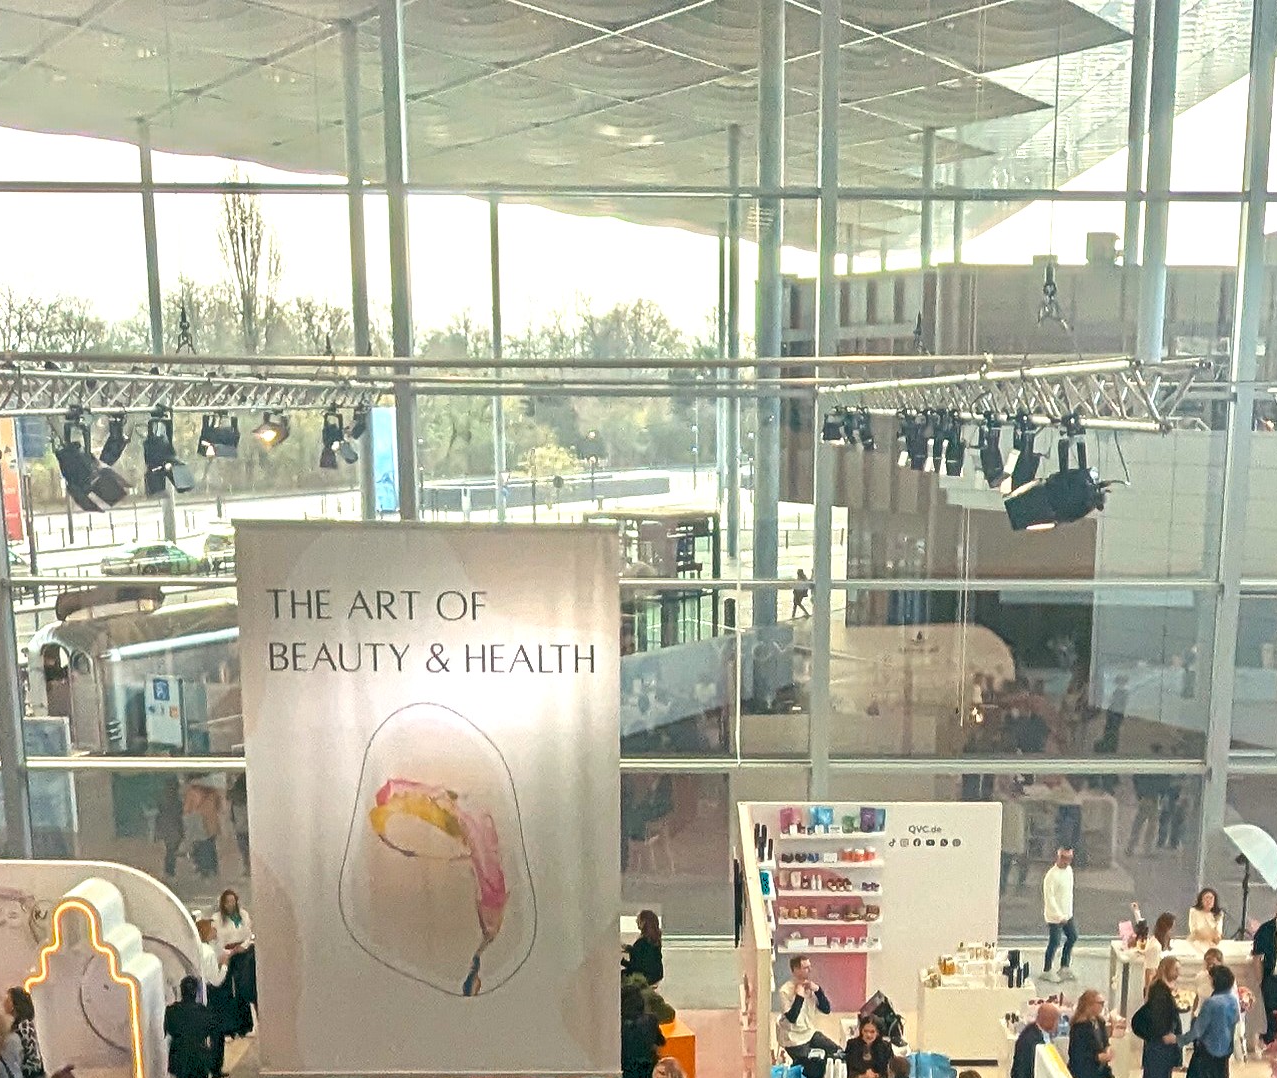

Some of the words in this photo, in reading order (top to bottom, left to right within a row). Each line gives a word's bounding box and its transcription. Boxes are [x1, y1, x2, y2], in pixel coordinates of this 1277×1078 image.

[266, 589, 332, 620] THE
[348, 590, 421, 620] ART
[437, 590, 487, 621] OF
[269, 642, 410, 672] BEAUTY
[426, 643, 450, 673] &
[466, 644, 595, 673] HEALTH
[908, 824, 942, 834] QVC.de
